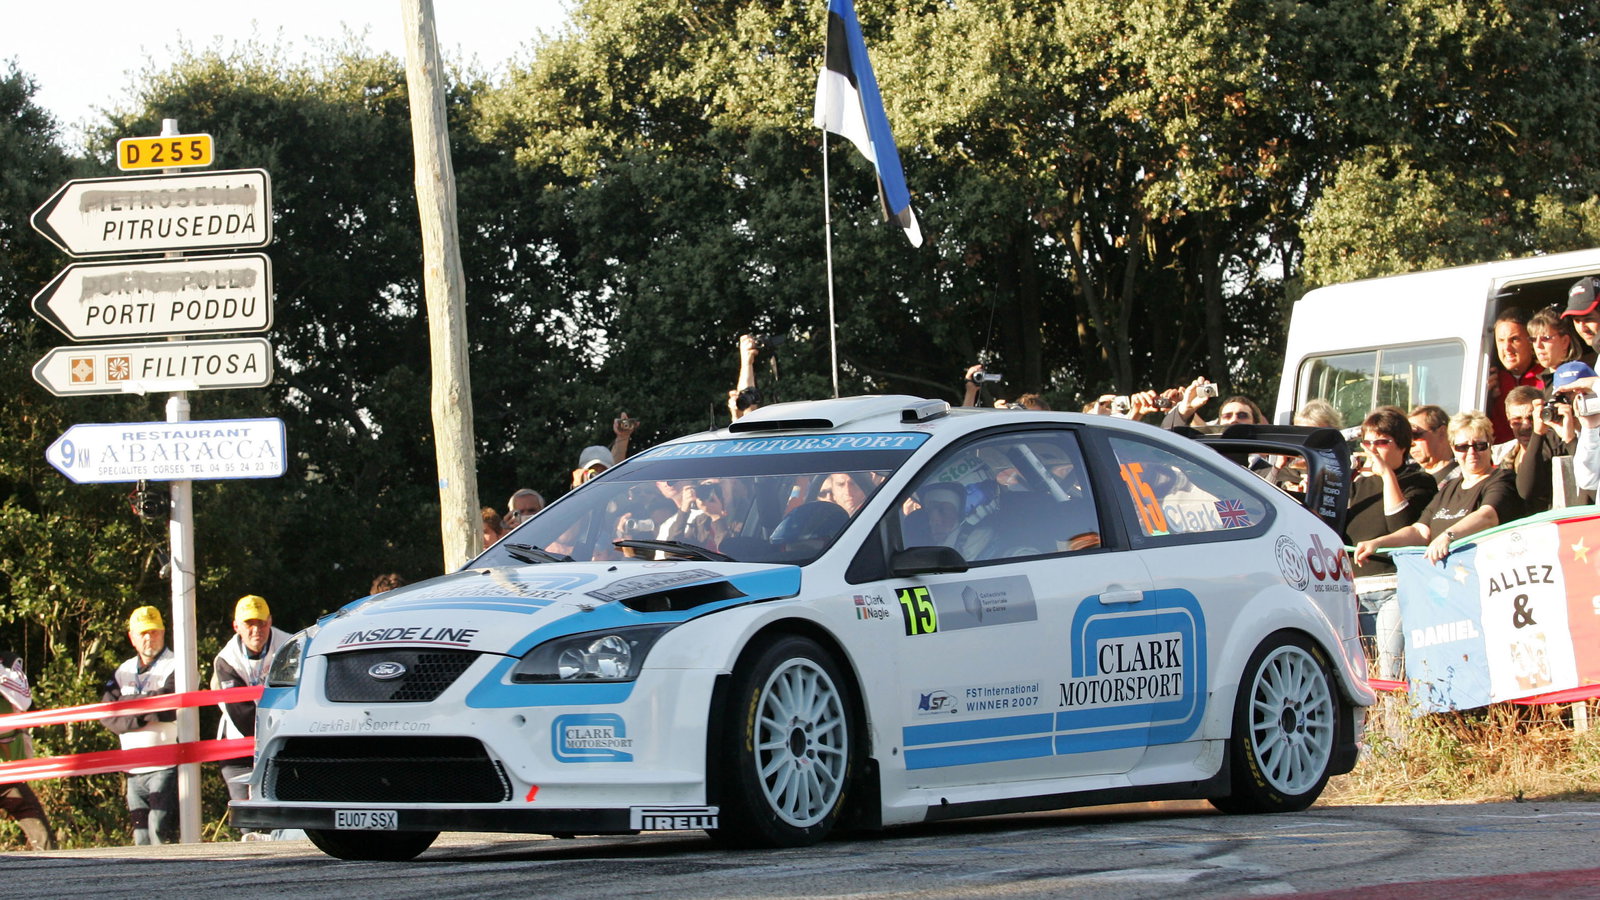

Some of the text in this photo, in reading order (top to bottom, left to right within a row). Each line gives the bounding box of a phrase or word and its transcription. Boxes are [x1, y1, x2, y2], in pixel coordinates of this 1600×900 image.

[127, 140, 203, 164] D 255
[103, 212, 256, 242] PITRUSEDDA
[86, 297, 256, 326] PORTI PODDU
[142, 353, 257, 378] FILITOSA
[122, 428, 252, 441] RESTAURANT
[724, 436, 914, 454] MOTORSPORT
[60, 439, 90, 469] 9 KM
[100, 440, 276, 463] A'BARACCA
[153, 464, 185, 474] CORSES
[190, 464, 204, 473] TEL
[209, 464, 220, 472] 04
[225, 463, 235, 472] 95
[240, 463, 250, 472] 24
[1120, 462, 1217, 534] 15 Clark
[1488, 565, 1555, 597] ALLEZ
[864, 595, 885, 606] Clark
[899, 587, 937, 635] 15
[1512, 593, 1537, 630] &
[867, 607, 890, 620] Nagle
[345, 627, 422, 645] INSIDE
[420, 627, 479, 643] LINE
[1411, 619, 1479, 649] DANIEL
[1098, 638, 1182, 675] CLARK
[966, 683, 1039, 698] FST International
[1059, 672, 1182, 707] MOTORSPORT
[966, 696, 1039, 711] WINNER 2007
[308, 718, 431, 733] ClarkRallySport.com
[566, 728, 613, 739] CLARK
[566, 738, 632, 748] MOTORSPORT
[338, 812, 395, 827] EU07 SSX
[630, 806, 720, 830] PIRELLI
